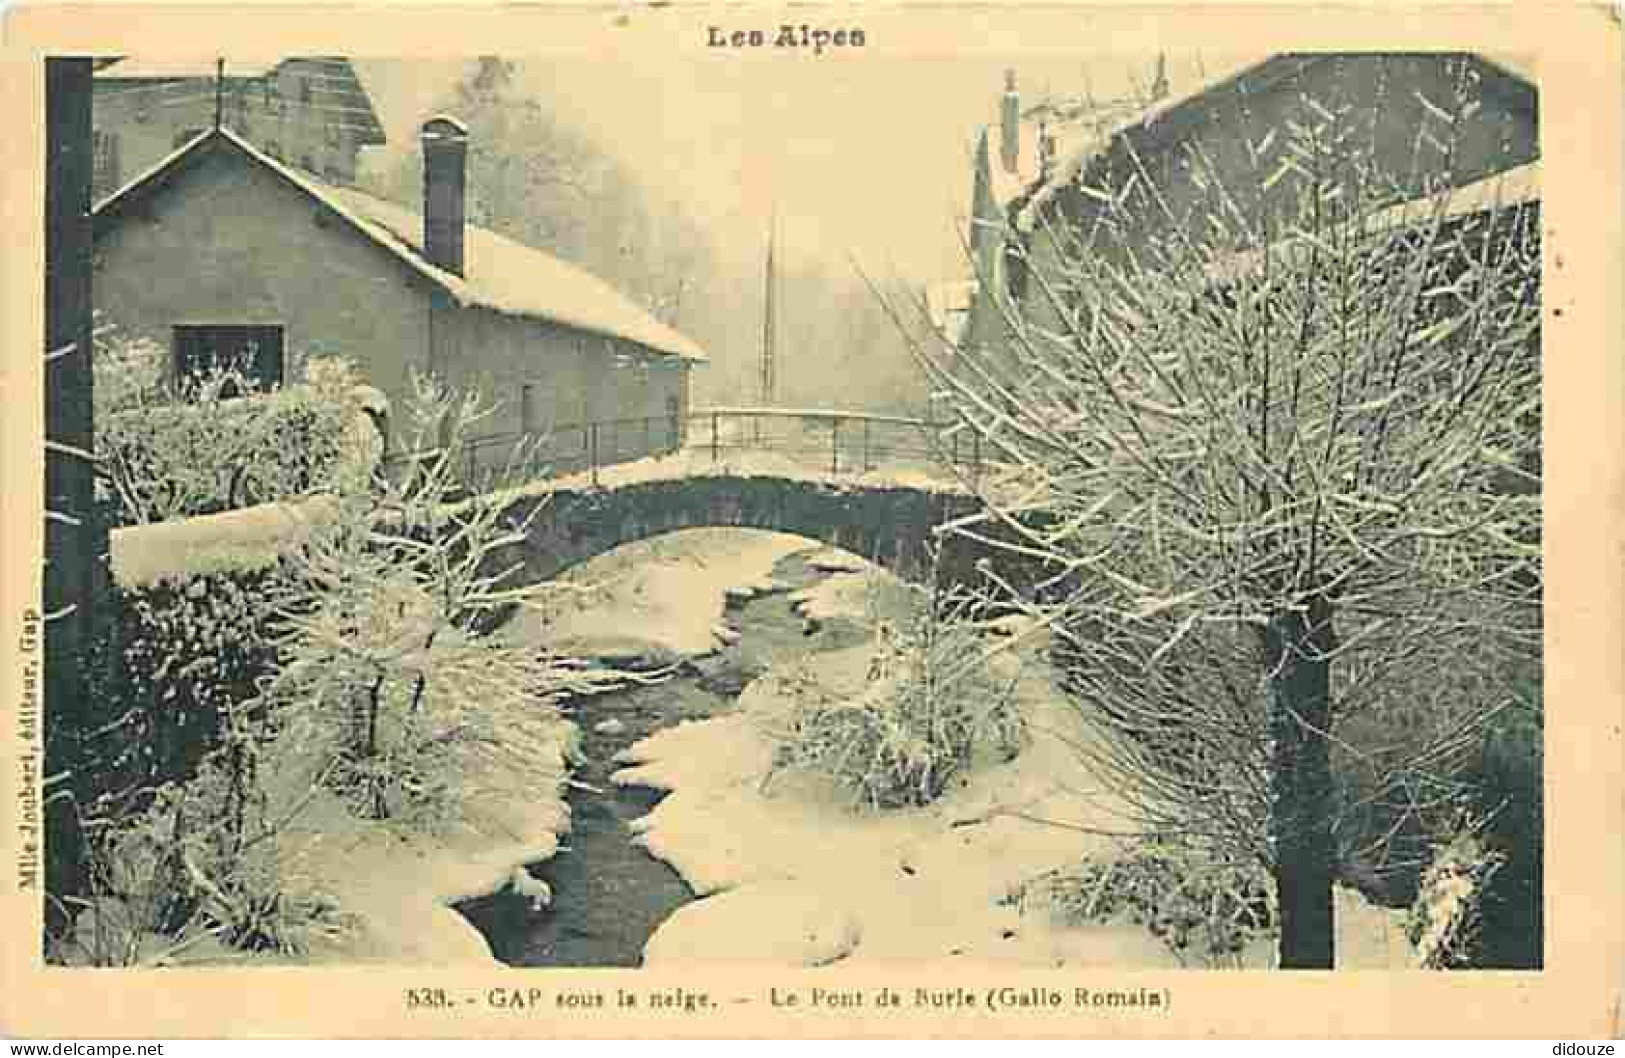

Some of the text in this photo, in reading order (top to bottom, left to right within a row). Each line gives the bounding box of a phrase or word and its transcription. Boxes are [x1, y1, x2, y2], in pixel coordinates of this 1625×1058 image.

[707, 24, 866, 54] Les Alpes
[18, 609, 39, 653] Gap
[487, 987, 542, 1009] GAP
[555, 988, 604, 1008] sous
[617, 987, 637, 1008] la
[770, 987, 798, 1008] Le
[811, 987, 863, 1008] Pont
[875, 987, 900, 1008] de
[986, 987, 1063, 1011] (Gallo
